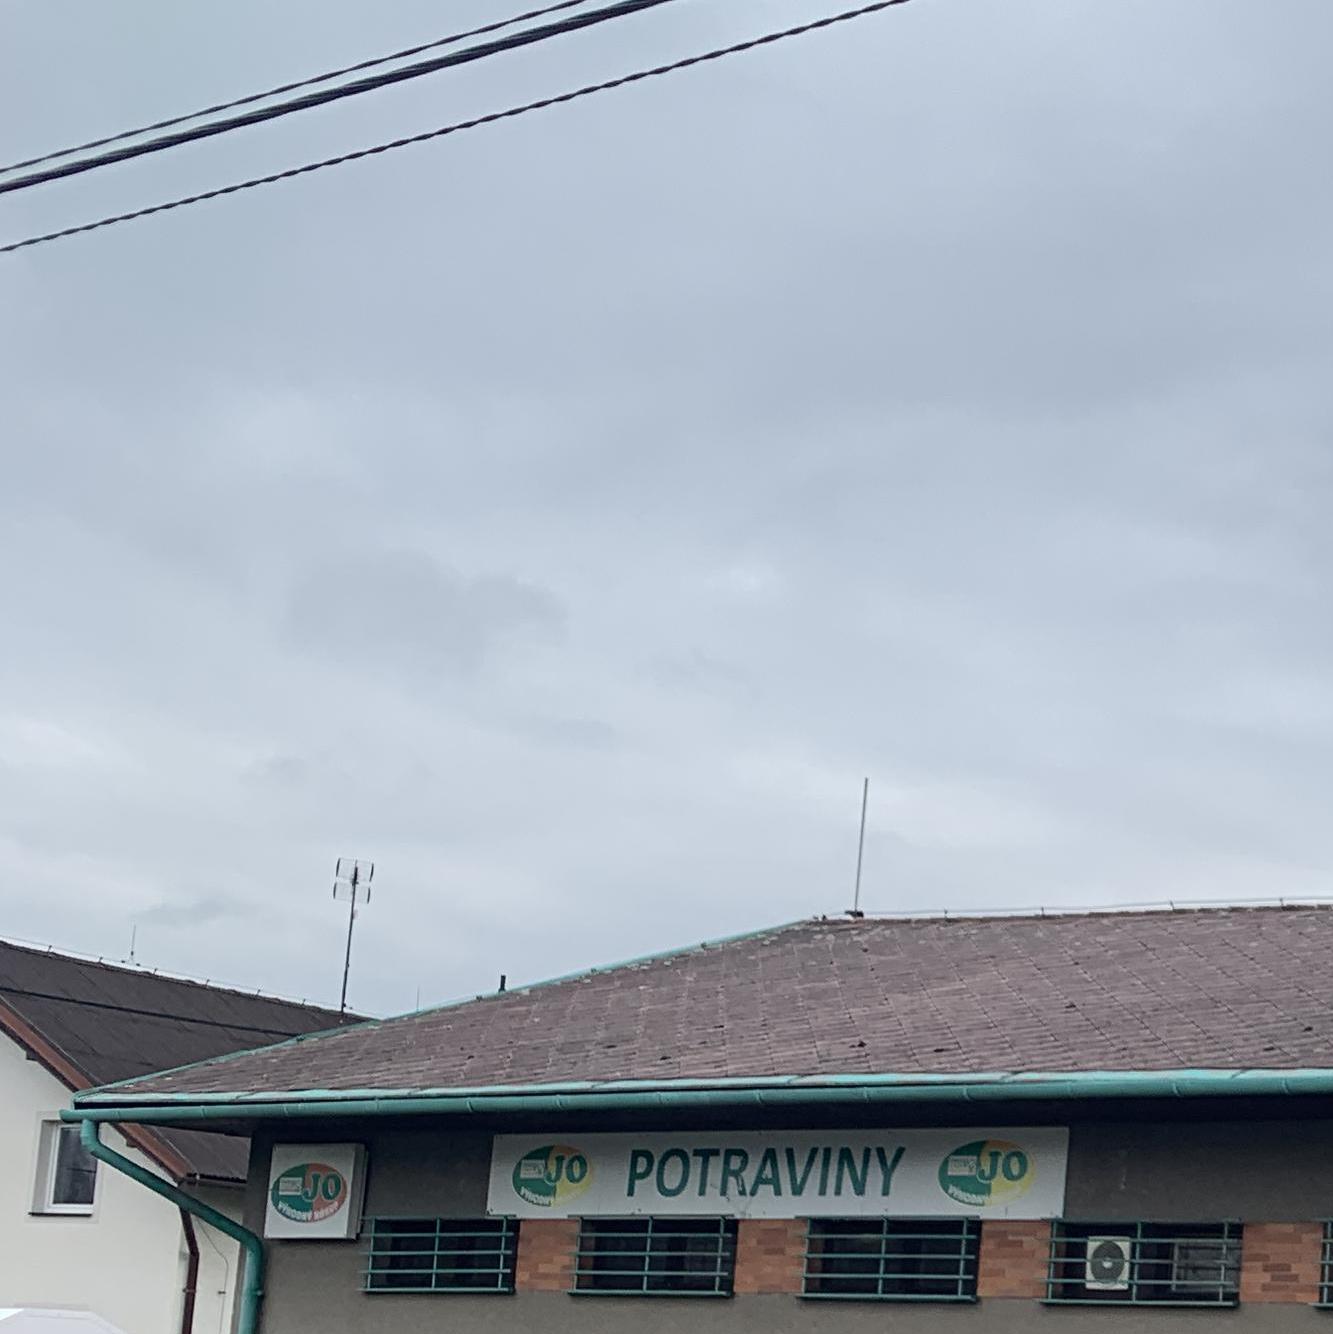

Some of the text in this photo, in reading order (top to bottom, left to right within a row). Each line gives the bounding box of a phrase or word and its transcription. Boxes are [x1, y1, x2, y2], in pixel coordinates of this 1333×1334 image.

[544, 1154, 588, 1184] JO
[626, 1146, 906, 1197] POTRAVINY
[976, 1150, 1029, 1182] JO
[301, 1173, 342, 1202] JO
